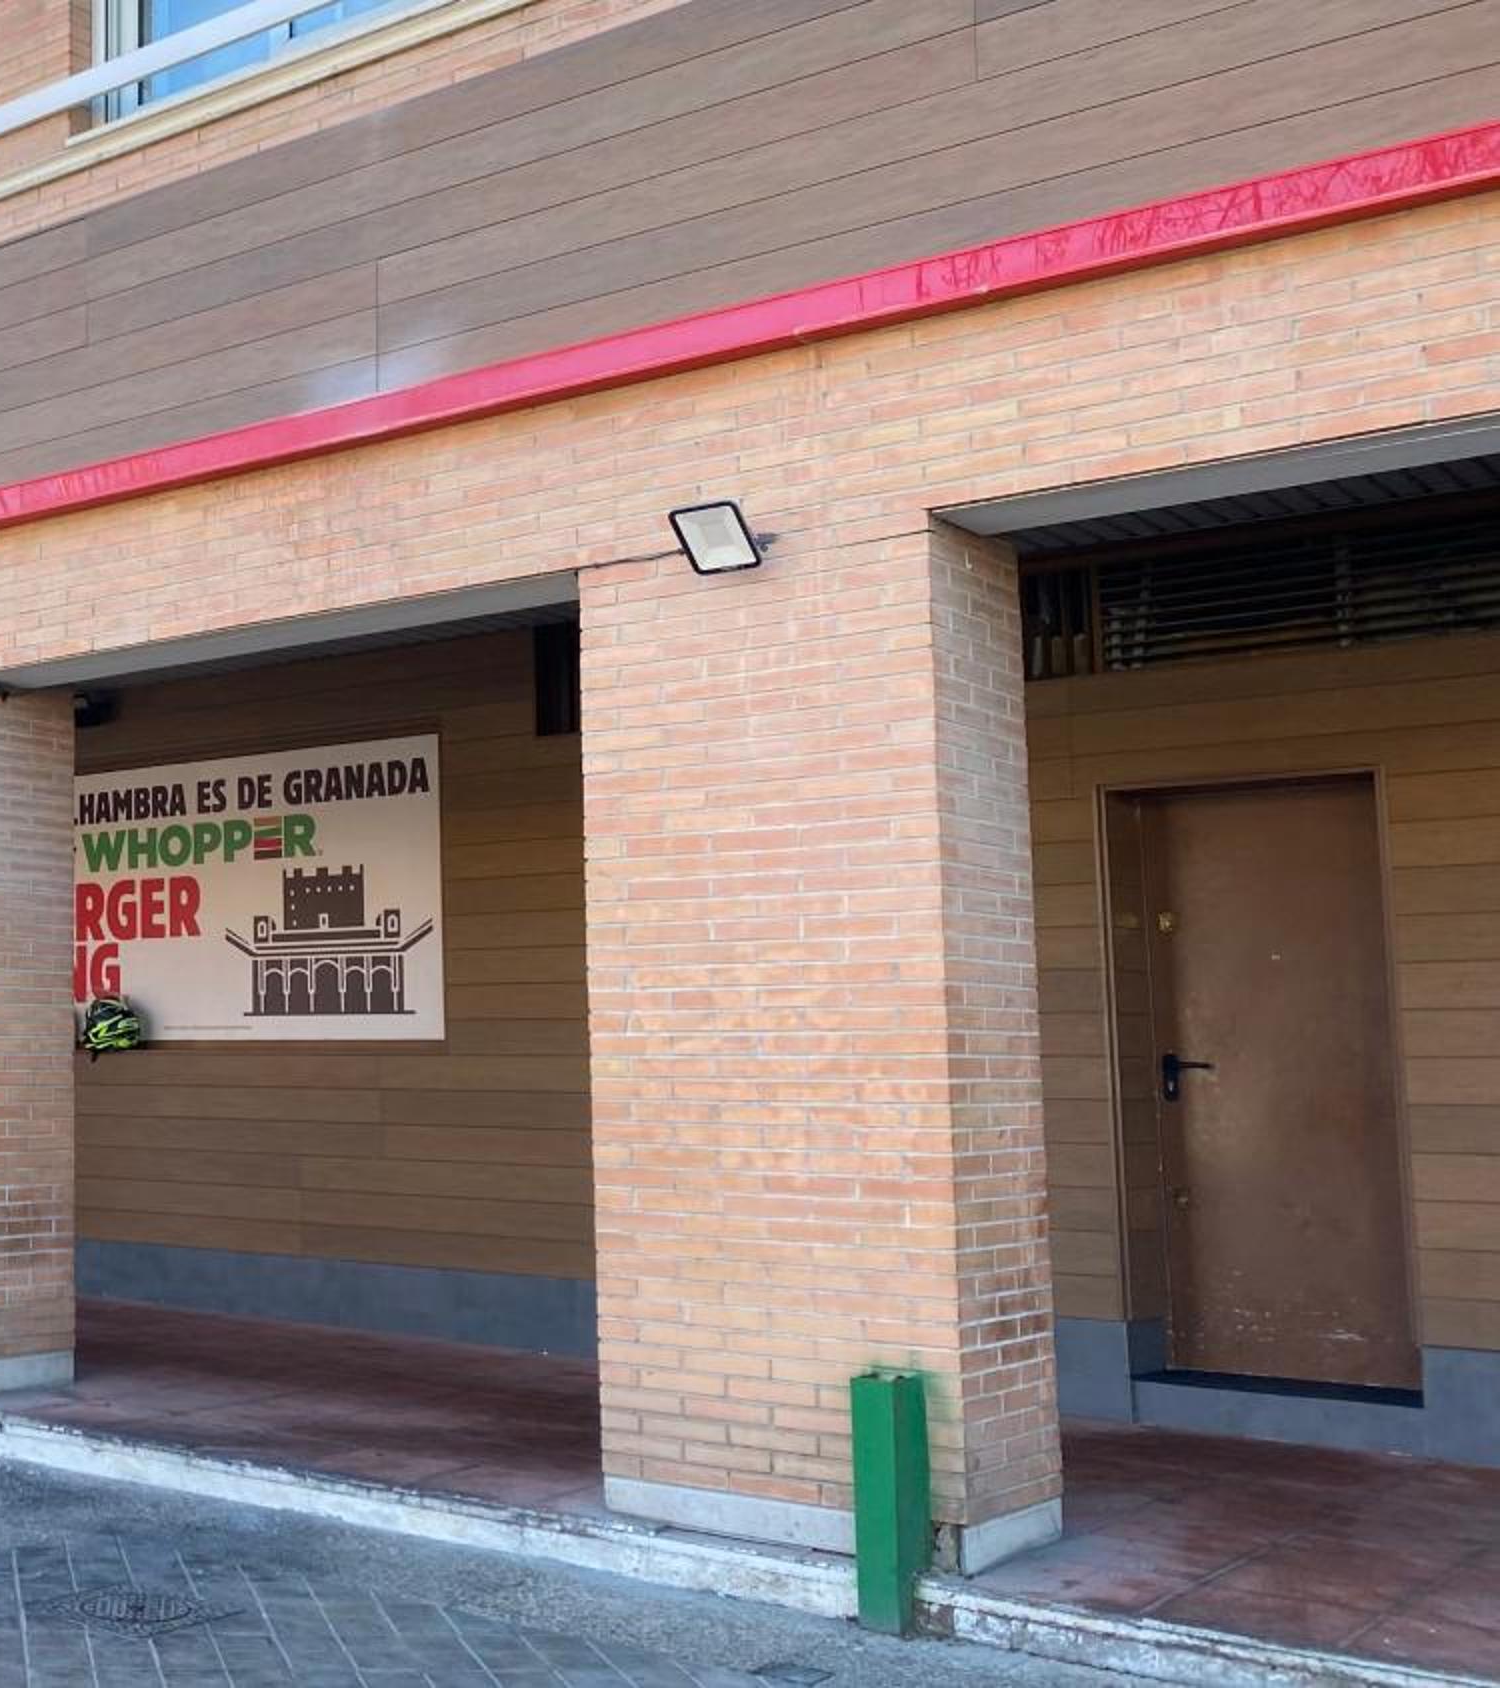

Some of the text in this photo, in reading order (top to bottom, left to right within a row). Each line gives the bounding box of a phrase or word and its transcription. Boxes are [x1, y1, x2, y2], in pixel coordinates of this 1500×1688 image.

[74, 757, 430, 826] HAMBRA ES DE GRANADA
[82, 813, 317, 873] WHOPPER
